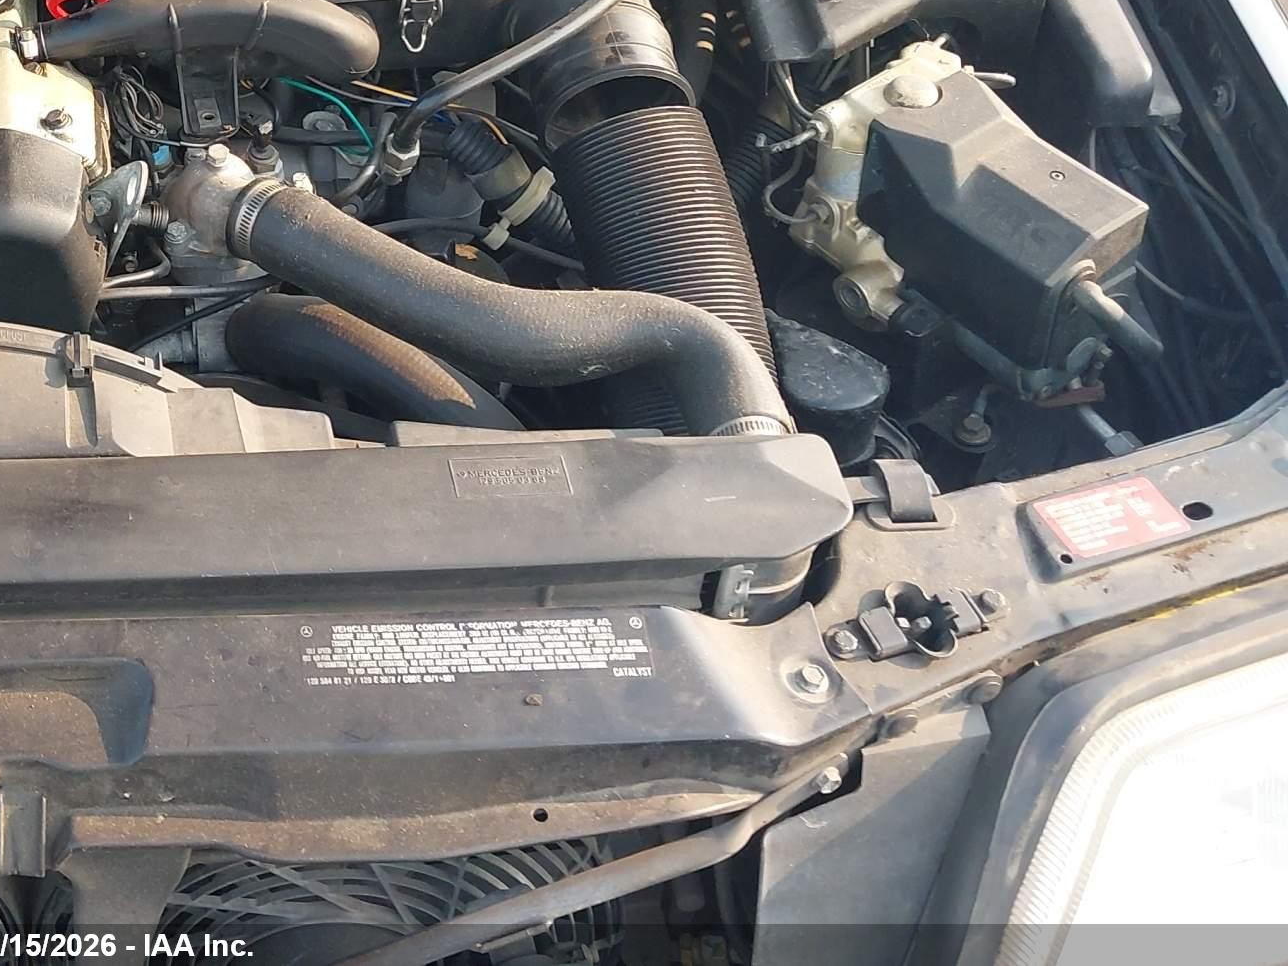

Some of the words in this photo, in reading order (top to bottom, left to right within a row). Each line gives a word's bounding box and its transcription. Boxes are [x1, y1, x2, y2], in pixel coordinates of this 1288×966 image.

[332, 625, 370, 633] VEHICLE
[371, 624, 413, 632] EMISSION
[416, 623, 457, 631] CONTROL
[612, 666, 653, 677] CATALYST
